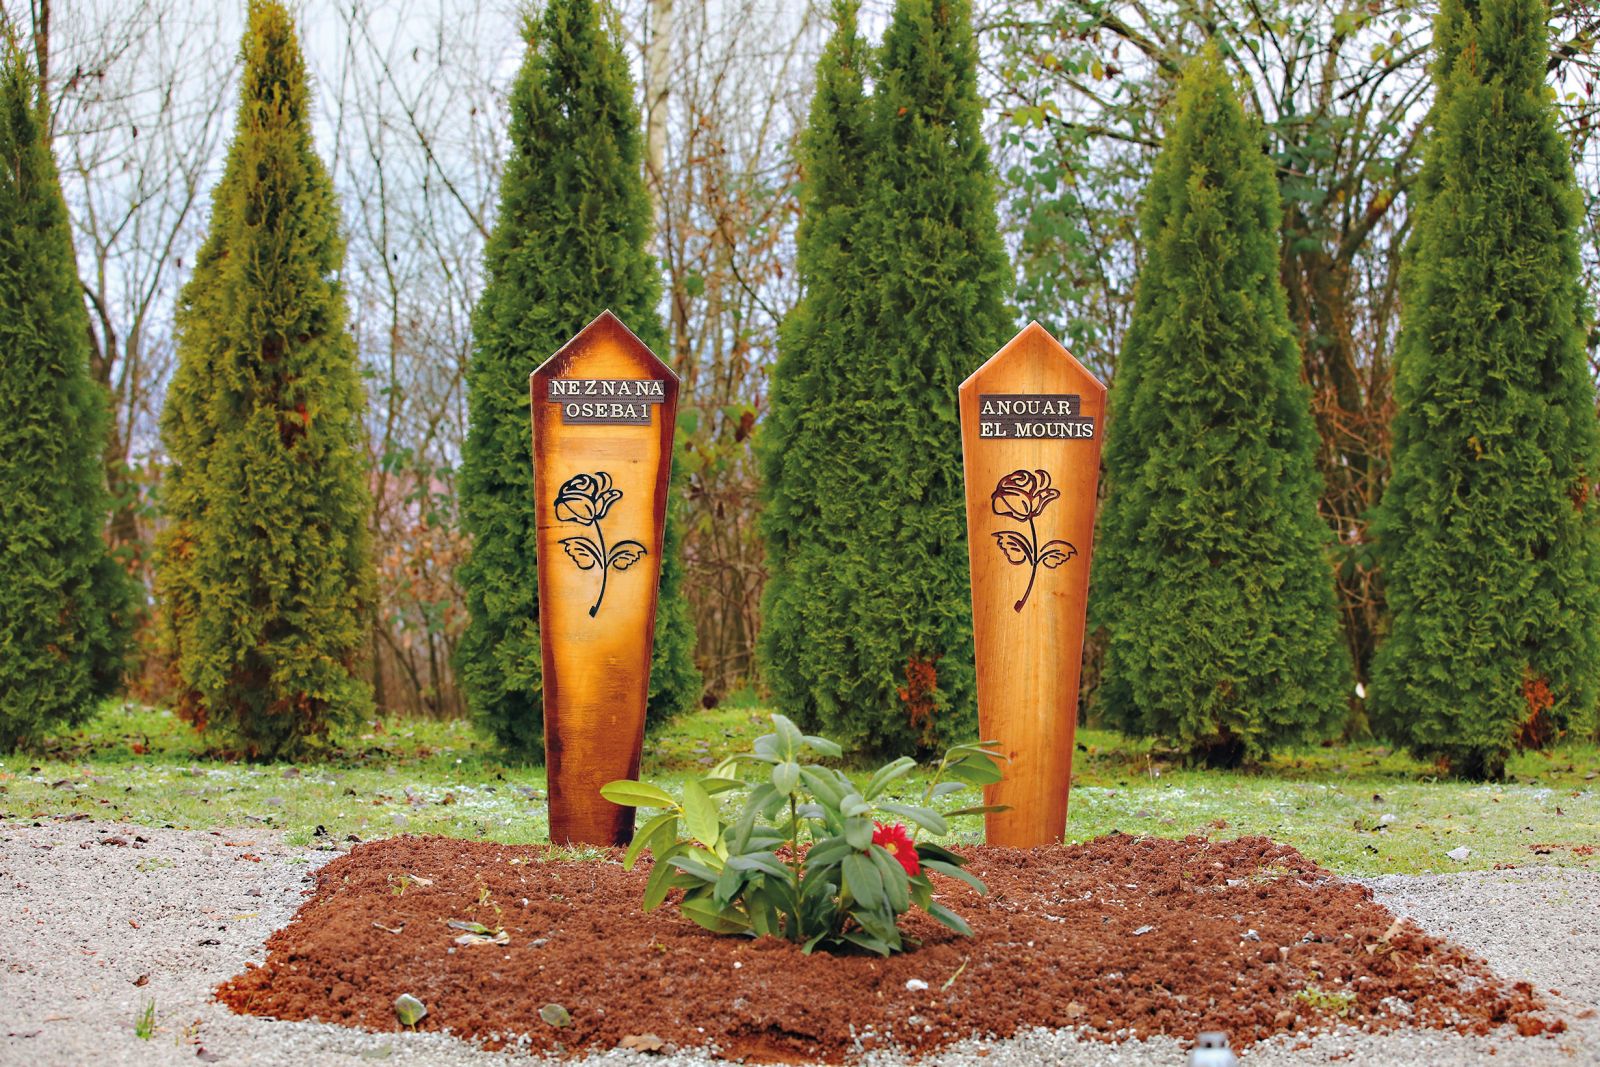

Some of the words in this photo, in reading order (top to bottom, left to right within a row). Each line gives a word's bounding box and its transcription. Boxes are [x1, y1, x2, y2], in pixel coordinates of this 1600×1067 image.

[551, 380, 664, 396] NEZNANA
[981, 400, 1072, 416] ANOUAR
[980, 422, 1007, 437] EL
[1014, 422, 1094, 438] MOUNIS
